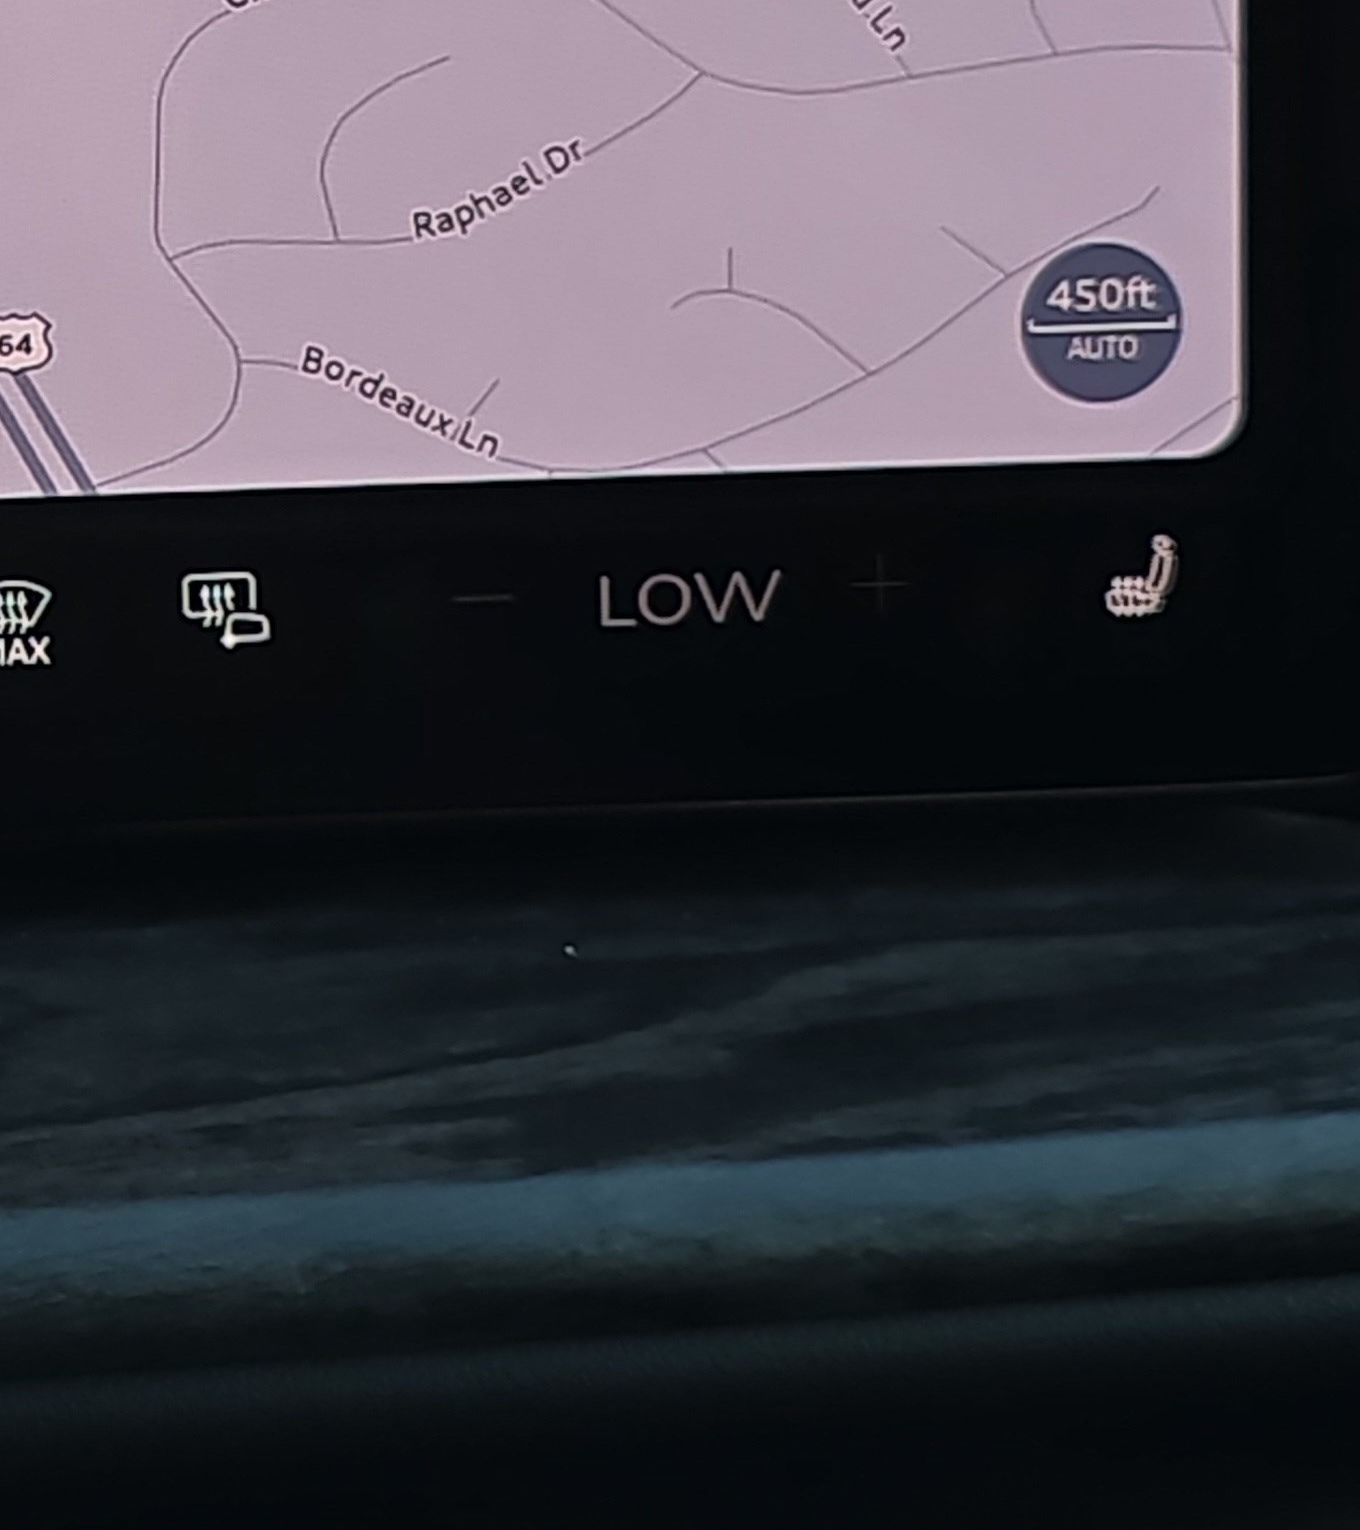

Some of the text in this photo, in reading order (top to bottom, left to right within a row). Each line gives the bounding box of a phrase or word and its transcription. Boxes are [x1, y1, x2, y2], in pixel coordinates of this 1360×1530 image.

[869, 5, 906, 52] Ln
[413, 139, 583, 238] Raphael Dr
[1046, 275, 1158, 313] 450ft
[1066, 335, 1139, 360] AUTO
[301, 346, 500, 457] Bordeaux Ln
[599, 569, 782, 627] LOW
